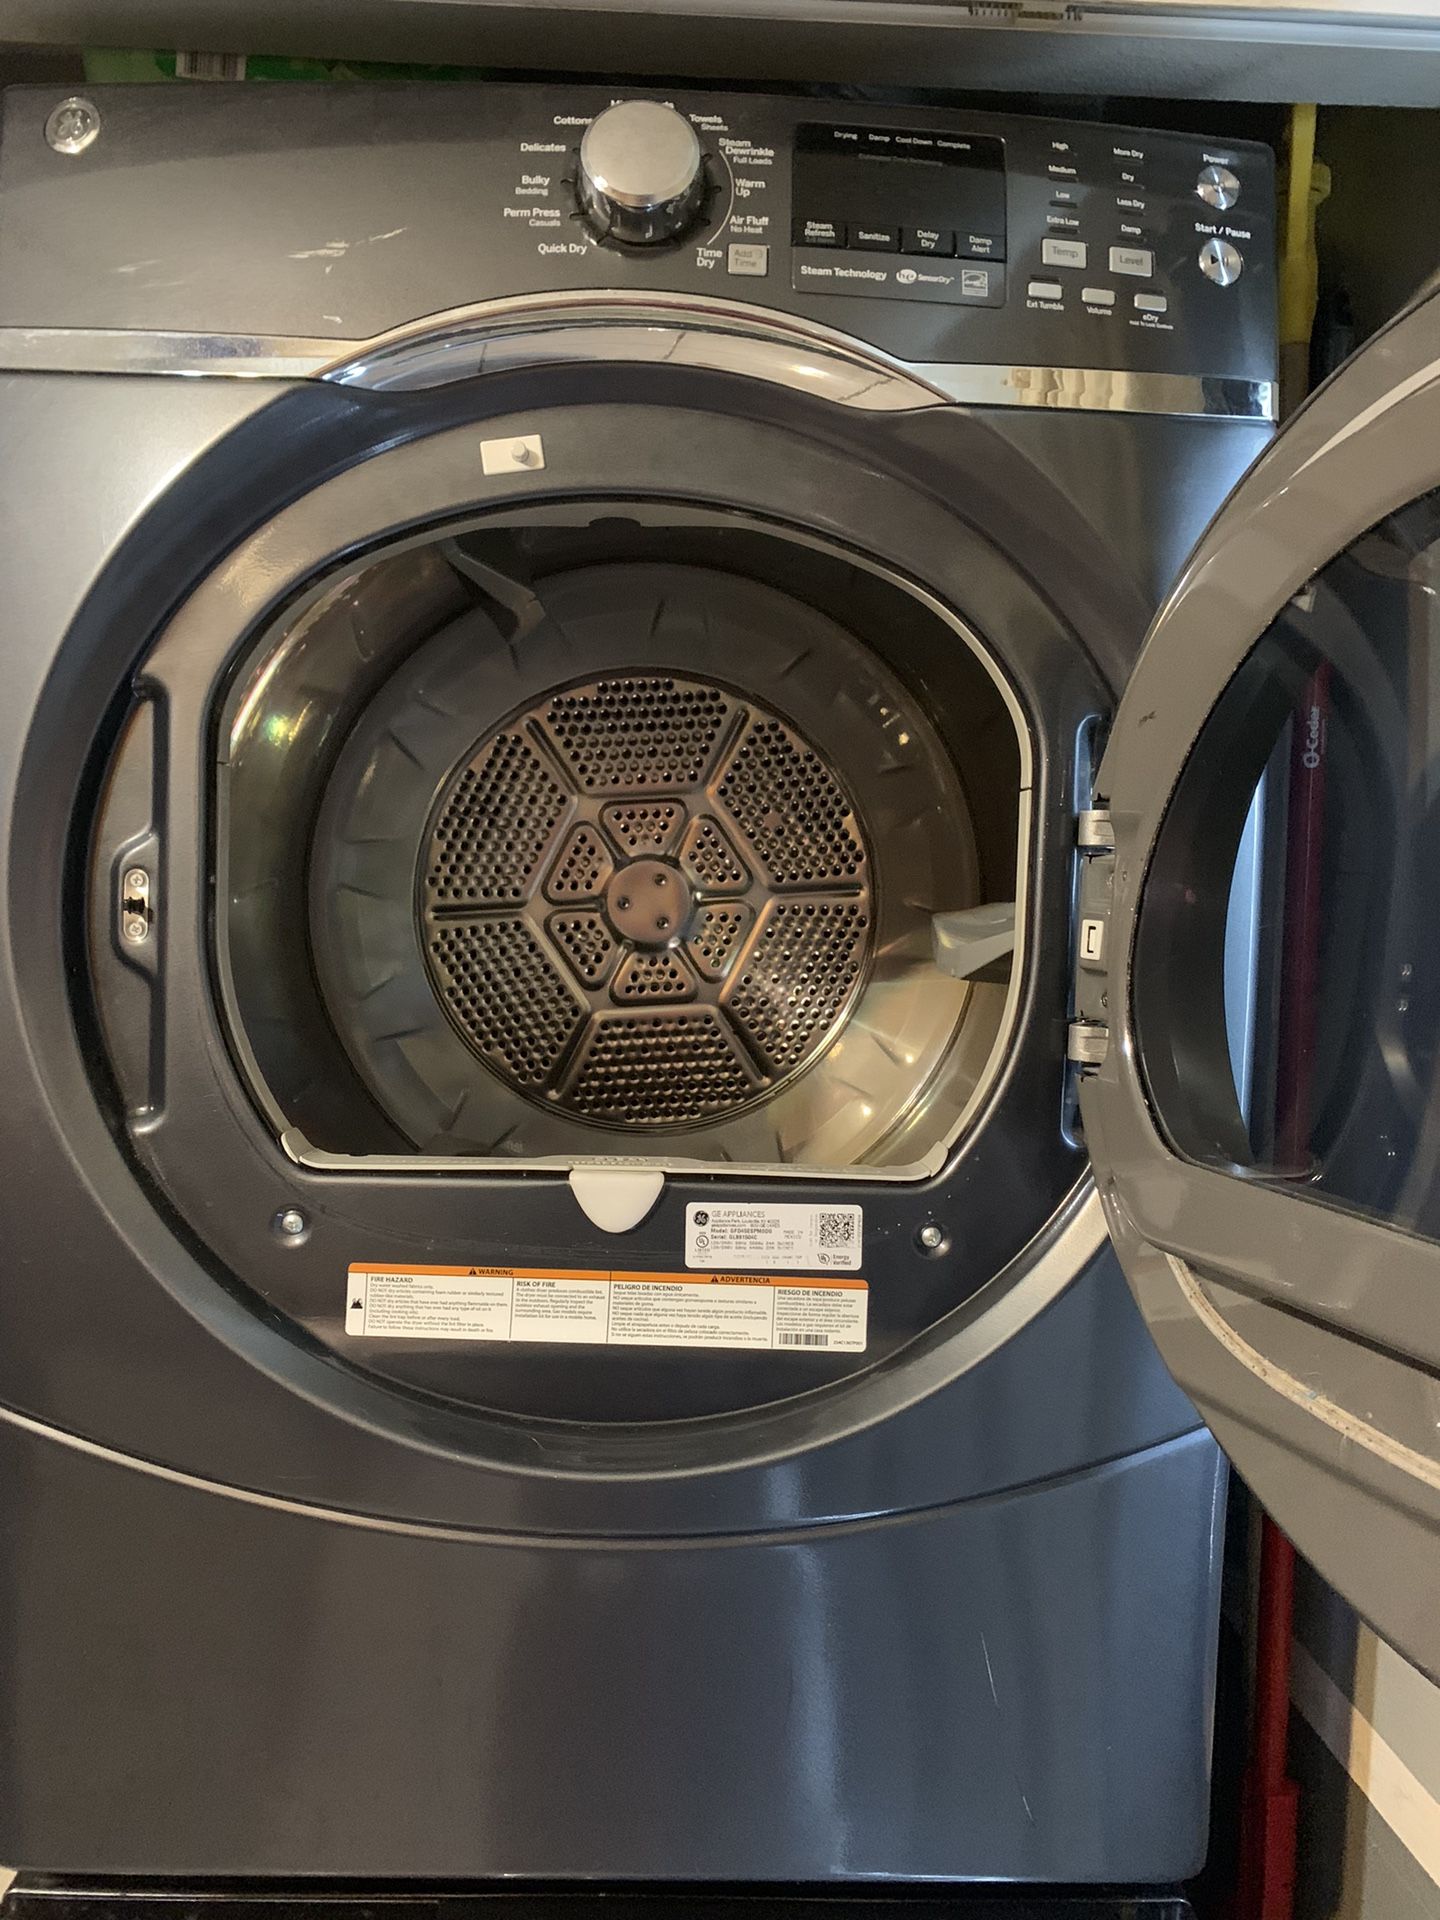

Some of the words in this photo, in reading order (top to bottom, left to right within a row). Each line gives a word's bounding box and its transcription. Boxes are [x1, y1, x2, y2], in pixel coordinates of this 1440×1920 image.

[689, 114, 722, 124] Towels
[520, 143, 566, 152] Delicates
[718, 138, 751, 148] Steam
[1203, 154, 1229, 165] Power
[522, 175, 550, 187] Bulky
[735, 178, 766, 189] Warm
[515, 187, 548, 196] Bedding
[736, 187, 750, 198] Up
[504, 208, 530, 218] Perm
[532, 208, 560, 218] Press
[528, 218, 561, 226] Casuals
[730, 216, 745, 225] Air
[747, 216, 769, 226] Fluff
[730, 225, 741, 233] No
[742, 225, 763, 234] Heat
[1195, 223, 1217, 234] Start
[1225, 228, 1251, 239] Pause
[921, 239, 936, 249] Dry
[538, 244, 566, 254] Quick
[569, 244, 588, 255] Dry
[697, 248, 722, 258] Time
[1053, 246, 1078, 258] Temp
[697, 257, 716, 268] Dry
[1119, 255, 1144, 267] Level
[801, 265, 832, 276] Steam
[834, 268, 887, 281] Technology
[479, 1268, 513, 1276] WARNING
[720, 1275, 770, 1284] ADVERTENCIA
